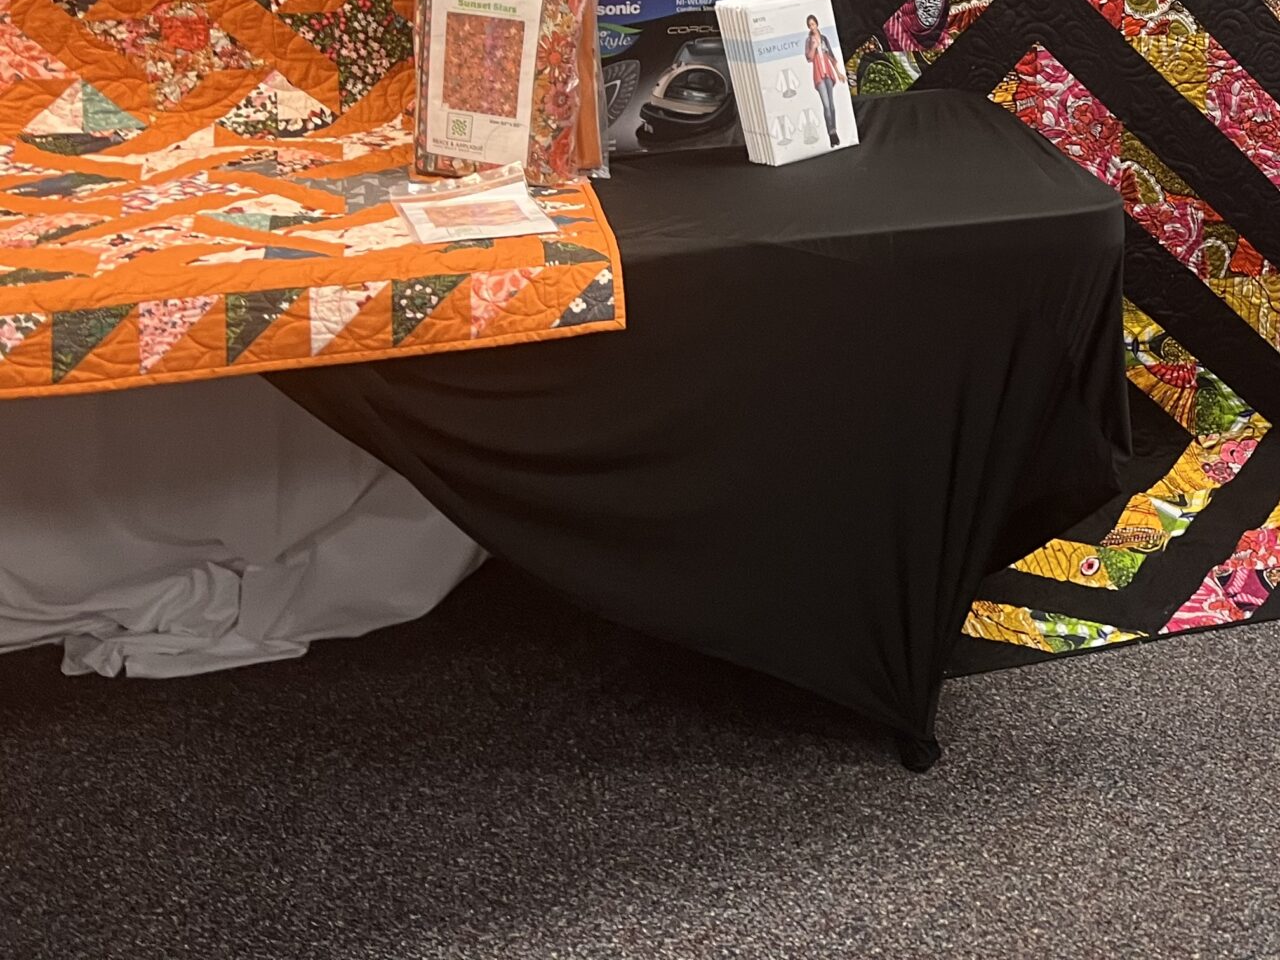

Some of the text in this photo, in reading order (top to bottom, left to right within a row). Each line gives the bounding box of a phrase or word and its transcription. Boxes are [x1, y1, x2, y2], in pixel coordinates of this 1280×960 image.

[493, 2, 517, 14] Stars
[597, 1, 641, 16] sonic
[757, 40, 801, 56] SIMPLICITY
